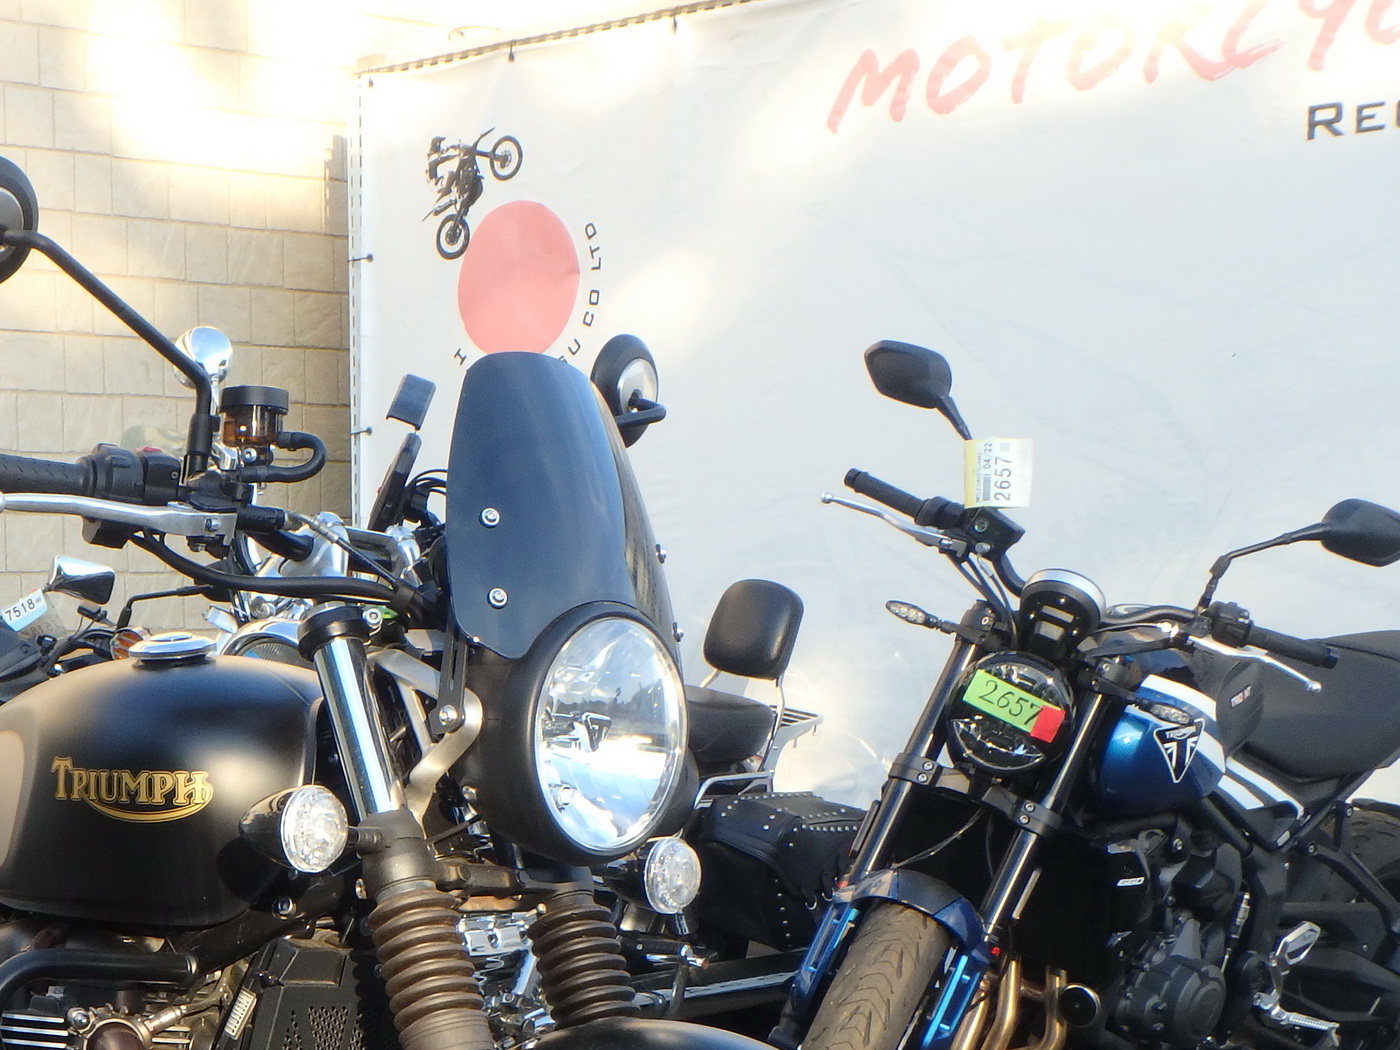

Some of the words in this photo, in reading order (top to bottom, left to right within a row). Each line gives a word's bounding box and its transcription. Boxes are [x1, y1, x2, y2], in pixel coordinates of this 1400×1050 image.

[1307, 100, 1400, 140] RE
[584, 222, 601, 271] LTD
[993, 456, 1013, 502] 2657
[4, 598, 36, 622] 7518
[978, 679, 1044, 726] 2657
[51, 756, 214, 820] TRIUMPH
